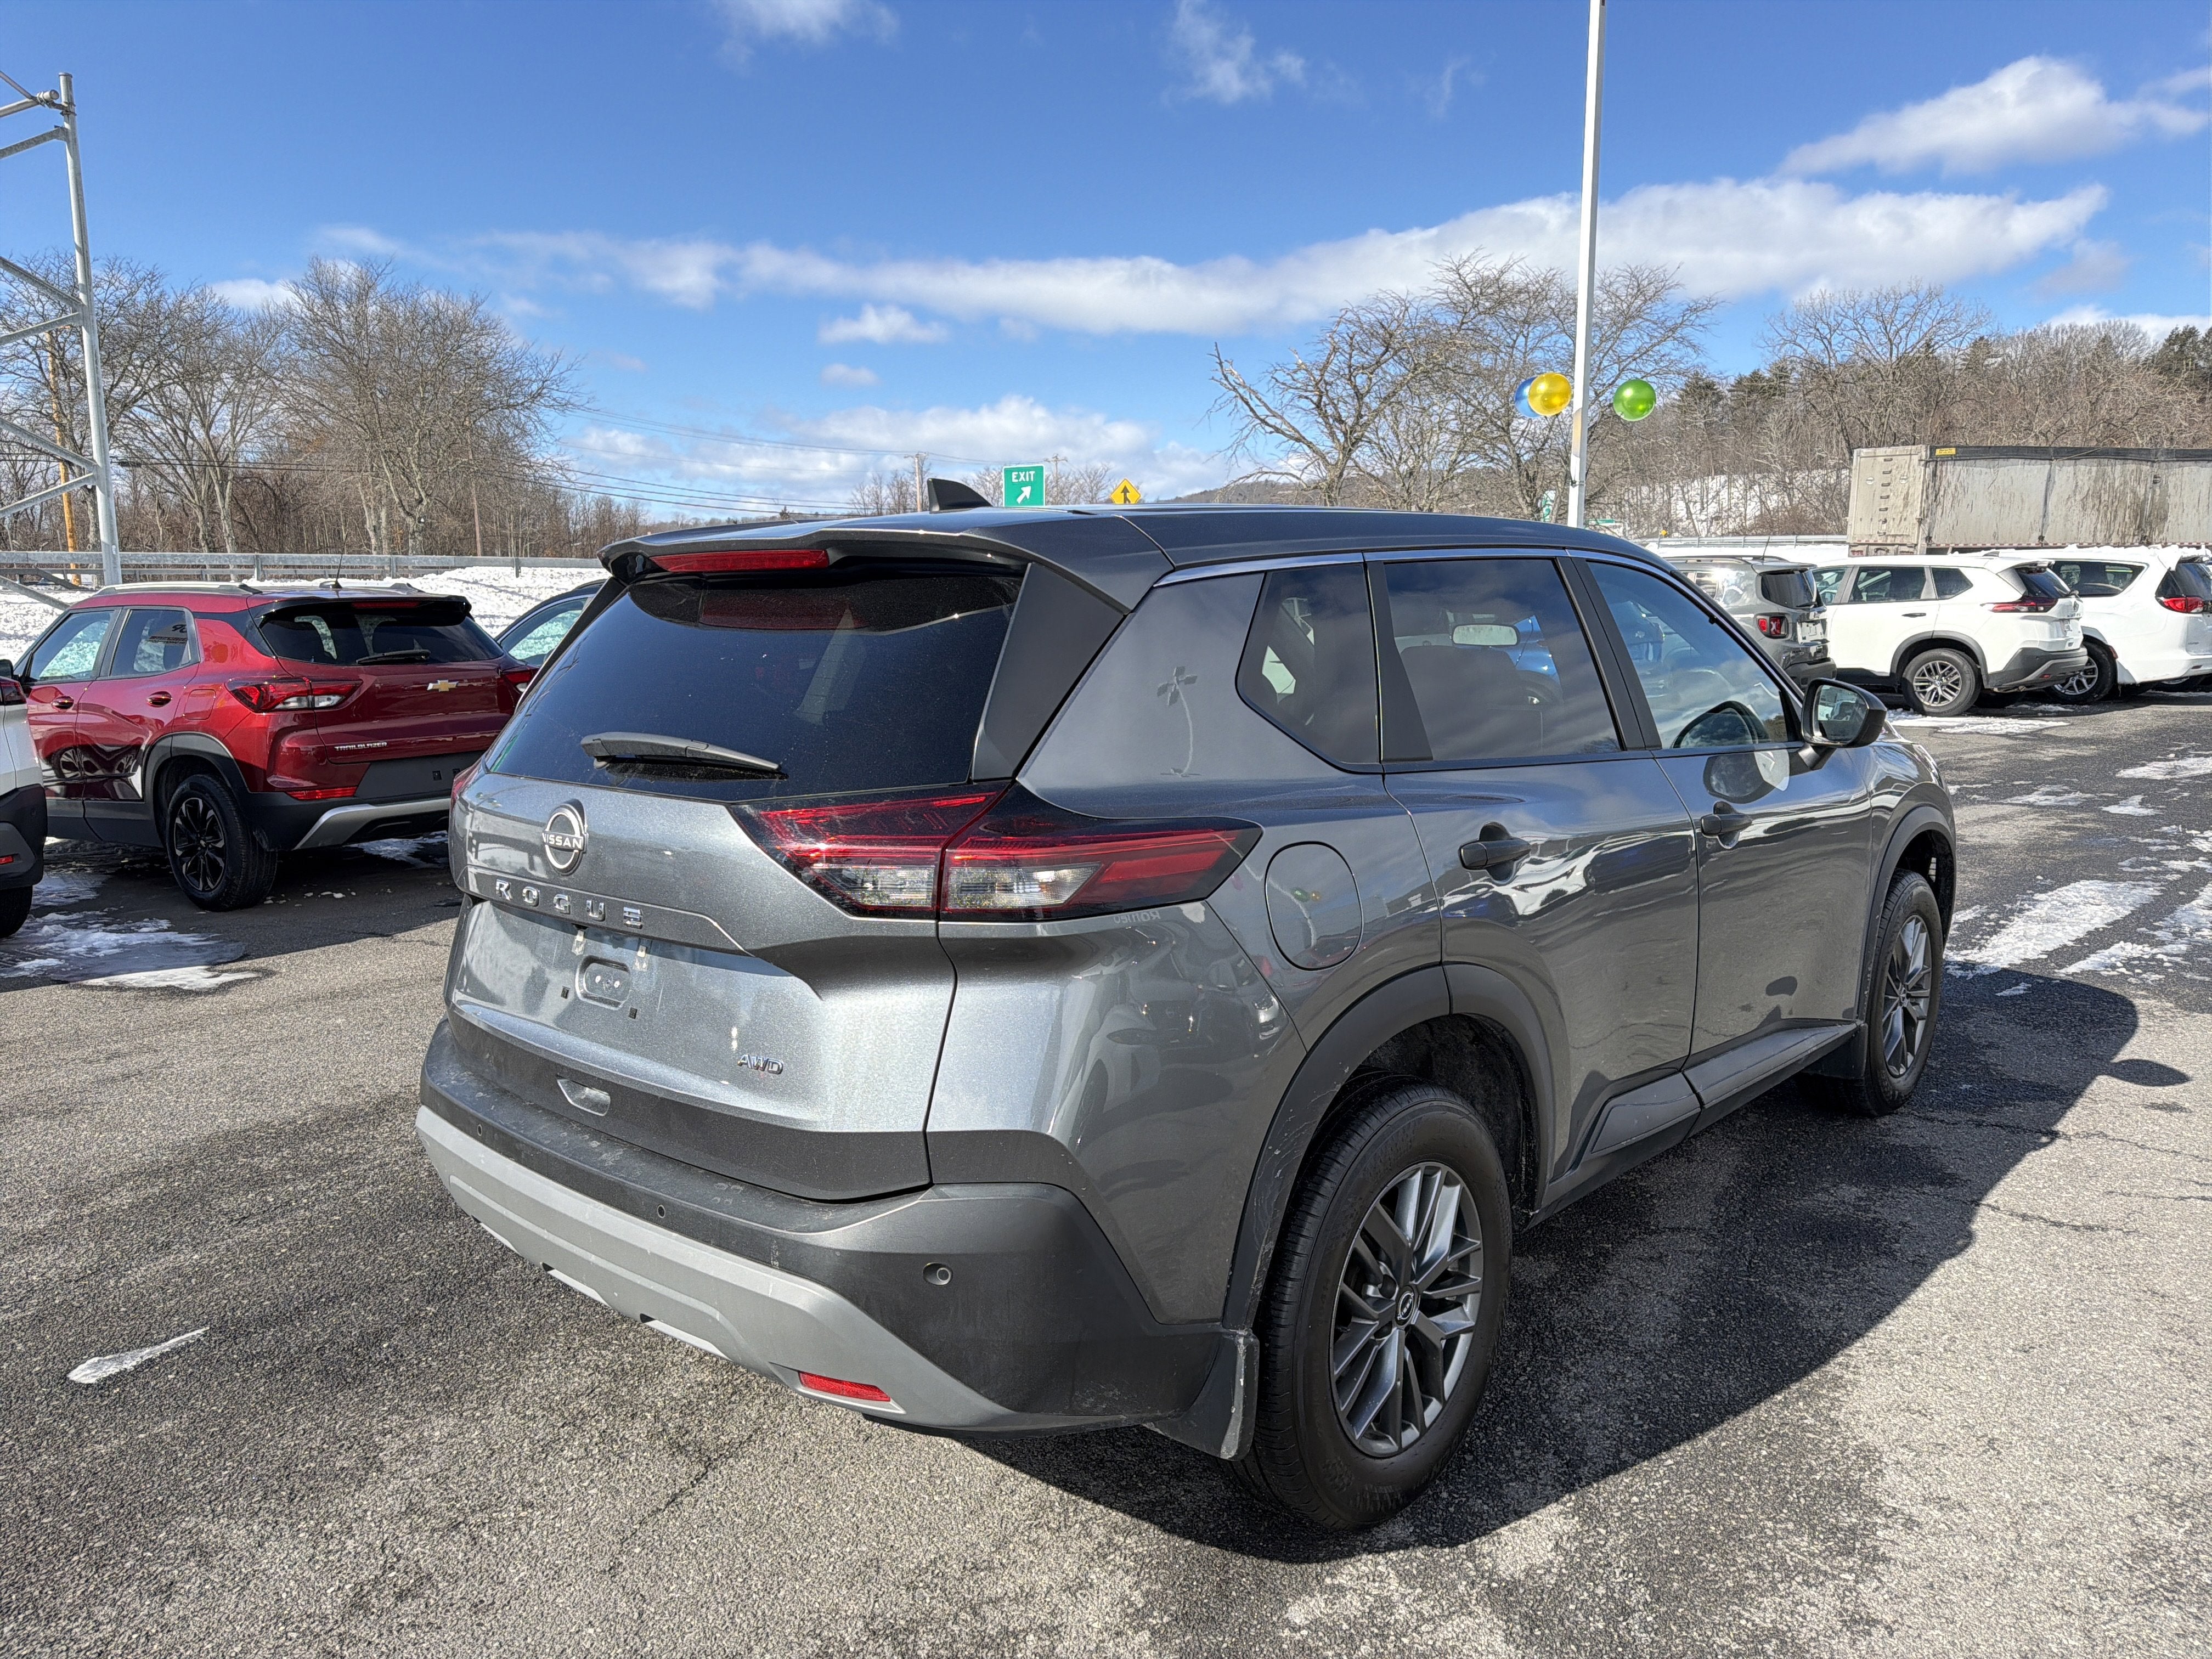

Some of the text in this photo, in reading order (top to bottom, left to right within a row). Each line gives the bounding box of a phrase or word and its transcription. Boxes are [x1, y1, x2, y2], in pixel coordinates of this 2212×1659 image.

[1012, 471, 1035, 482] EXIT
[334, 742, 387, 751] TRAILBLAZER
[542, 832, 583, 849] NISSAN
[495, 878, 642, 929] ROGUE
[737, 1054, 784, 1075] AWD
